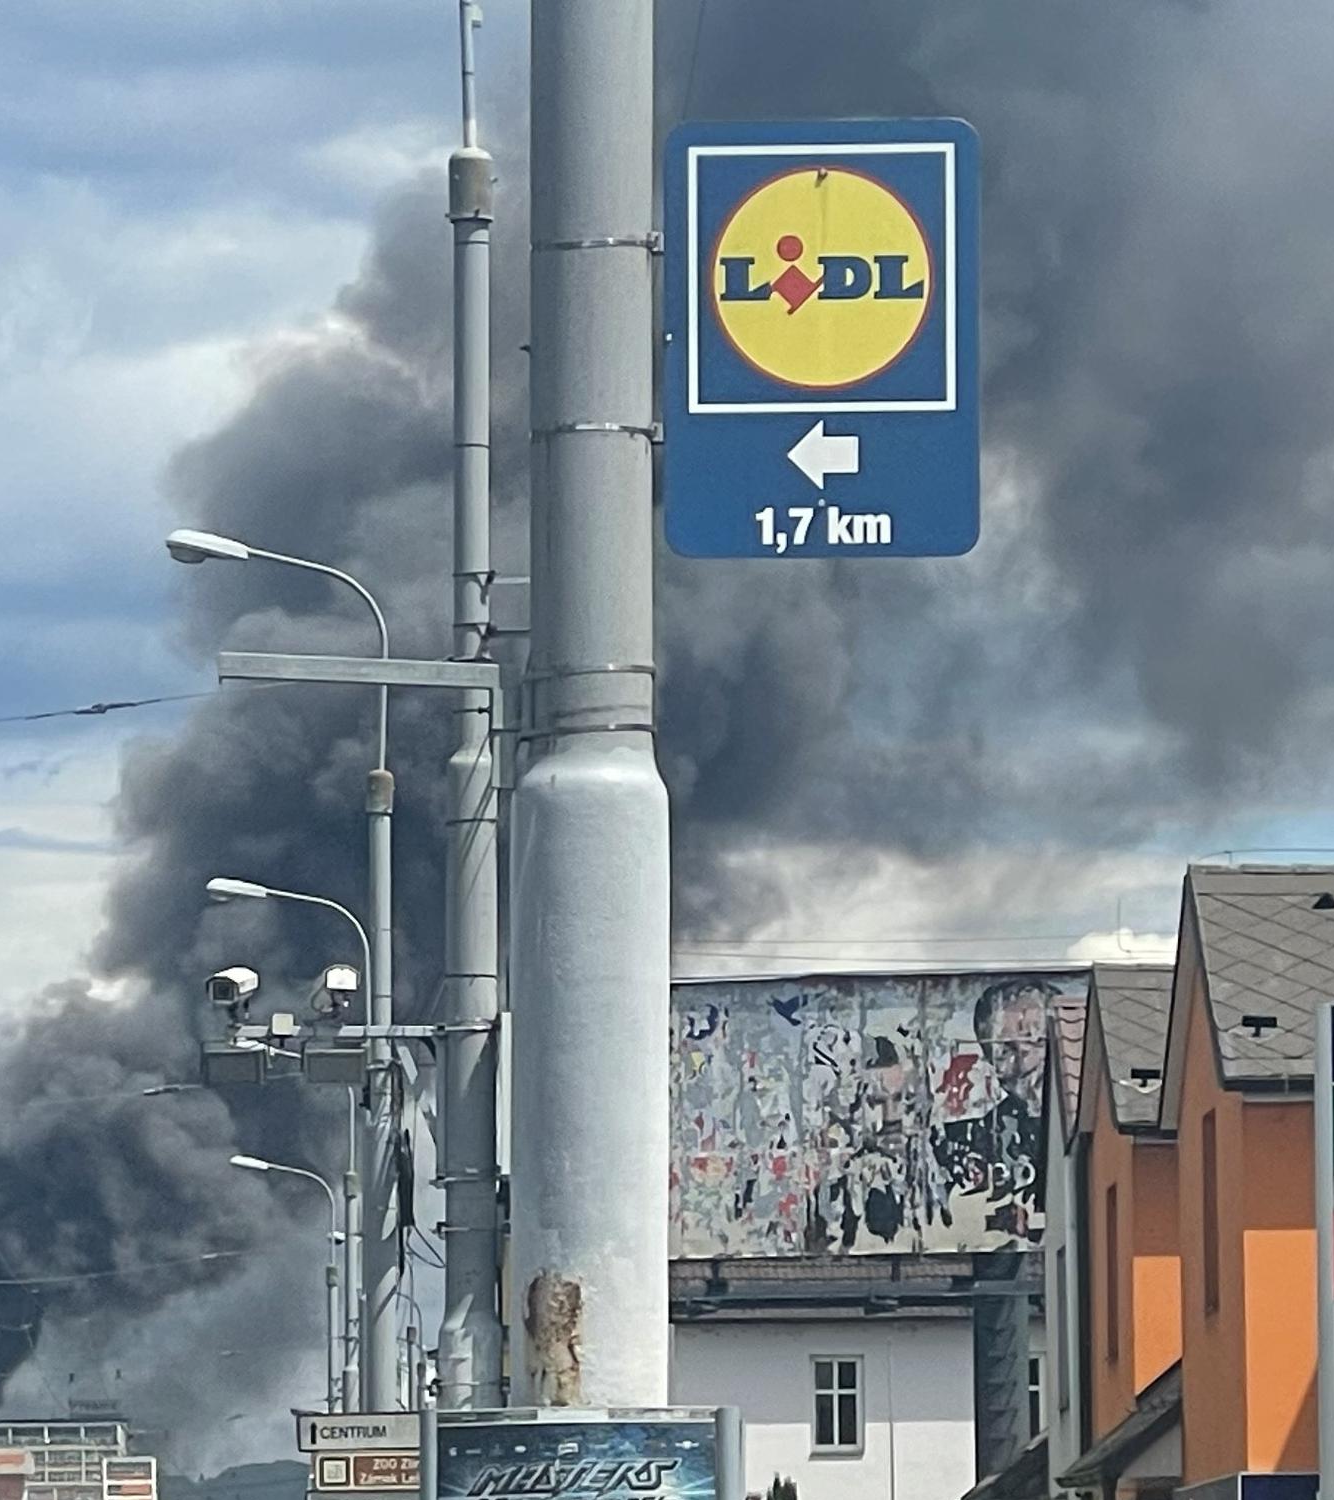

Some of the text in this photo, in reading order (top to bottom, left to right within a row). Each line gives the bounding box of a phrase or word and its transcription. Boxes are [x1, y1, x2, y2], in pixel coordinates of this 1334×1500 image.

[755, 506, 892, 554] 1,7 km
[320, 1425, 387, 1440] CENTRUM
[373, 1458, 398, 1470] ZOO
[467, 1458, 682, 1498] MASTERS
